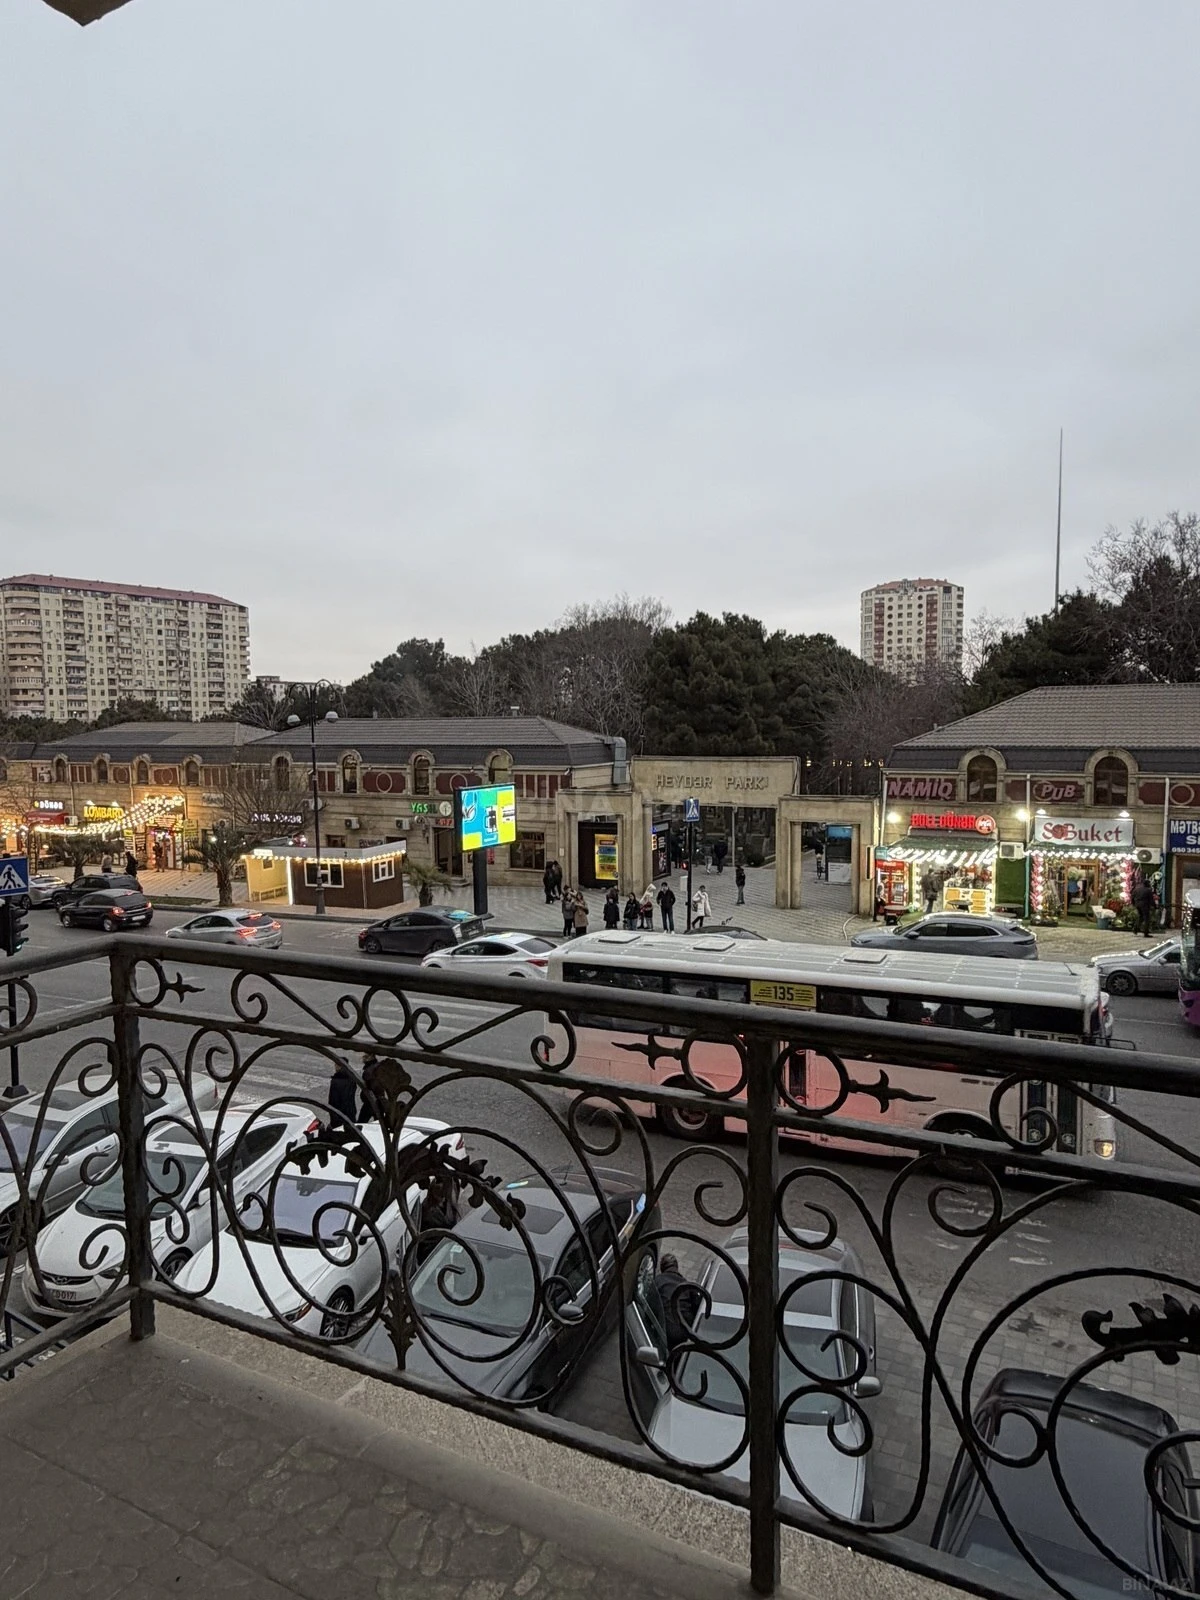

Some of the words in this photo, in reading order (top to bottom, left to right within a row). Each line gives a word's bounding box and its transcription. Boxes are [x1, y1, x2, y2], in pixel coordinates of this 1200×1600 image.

[656, 774, 713, 789] HEYDƏR
[1041, 784, 1076, 800] PUB
[83, 805, 124, 819] LOMBARD
[773, 985, 794, 1001] 135
